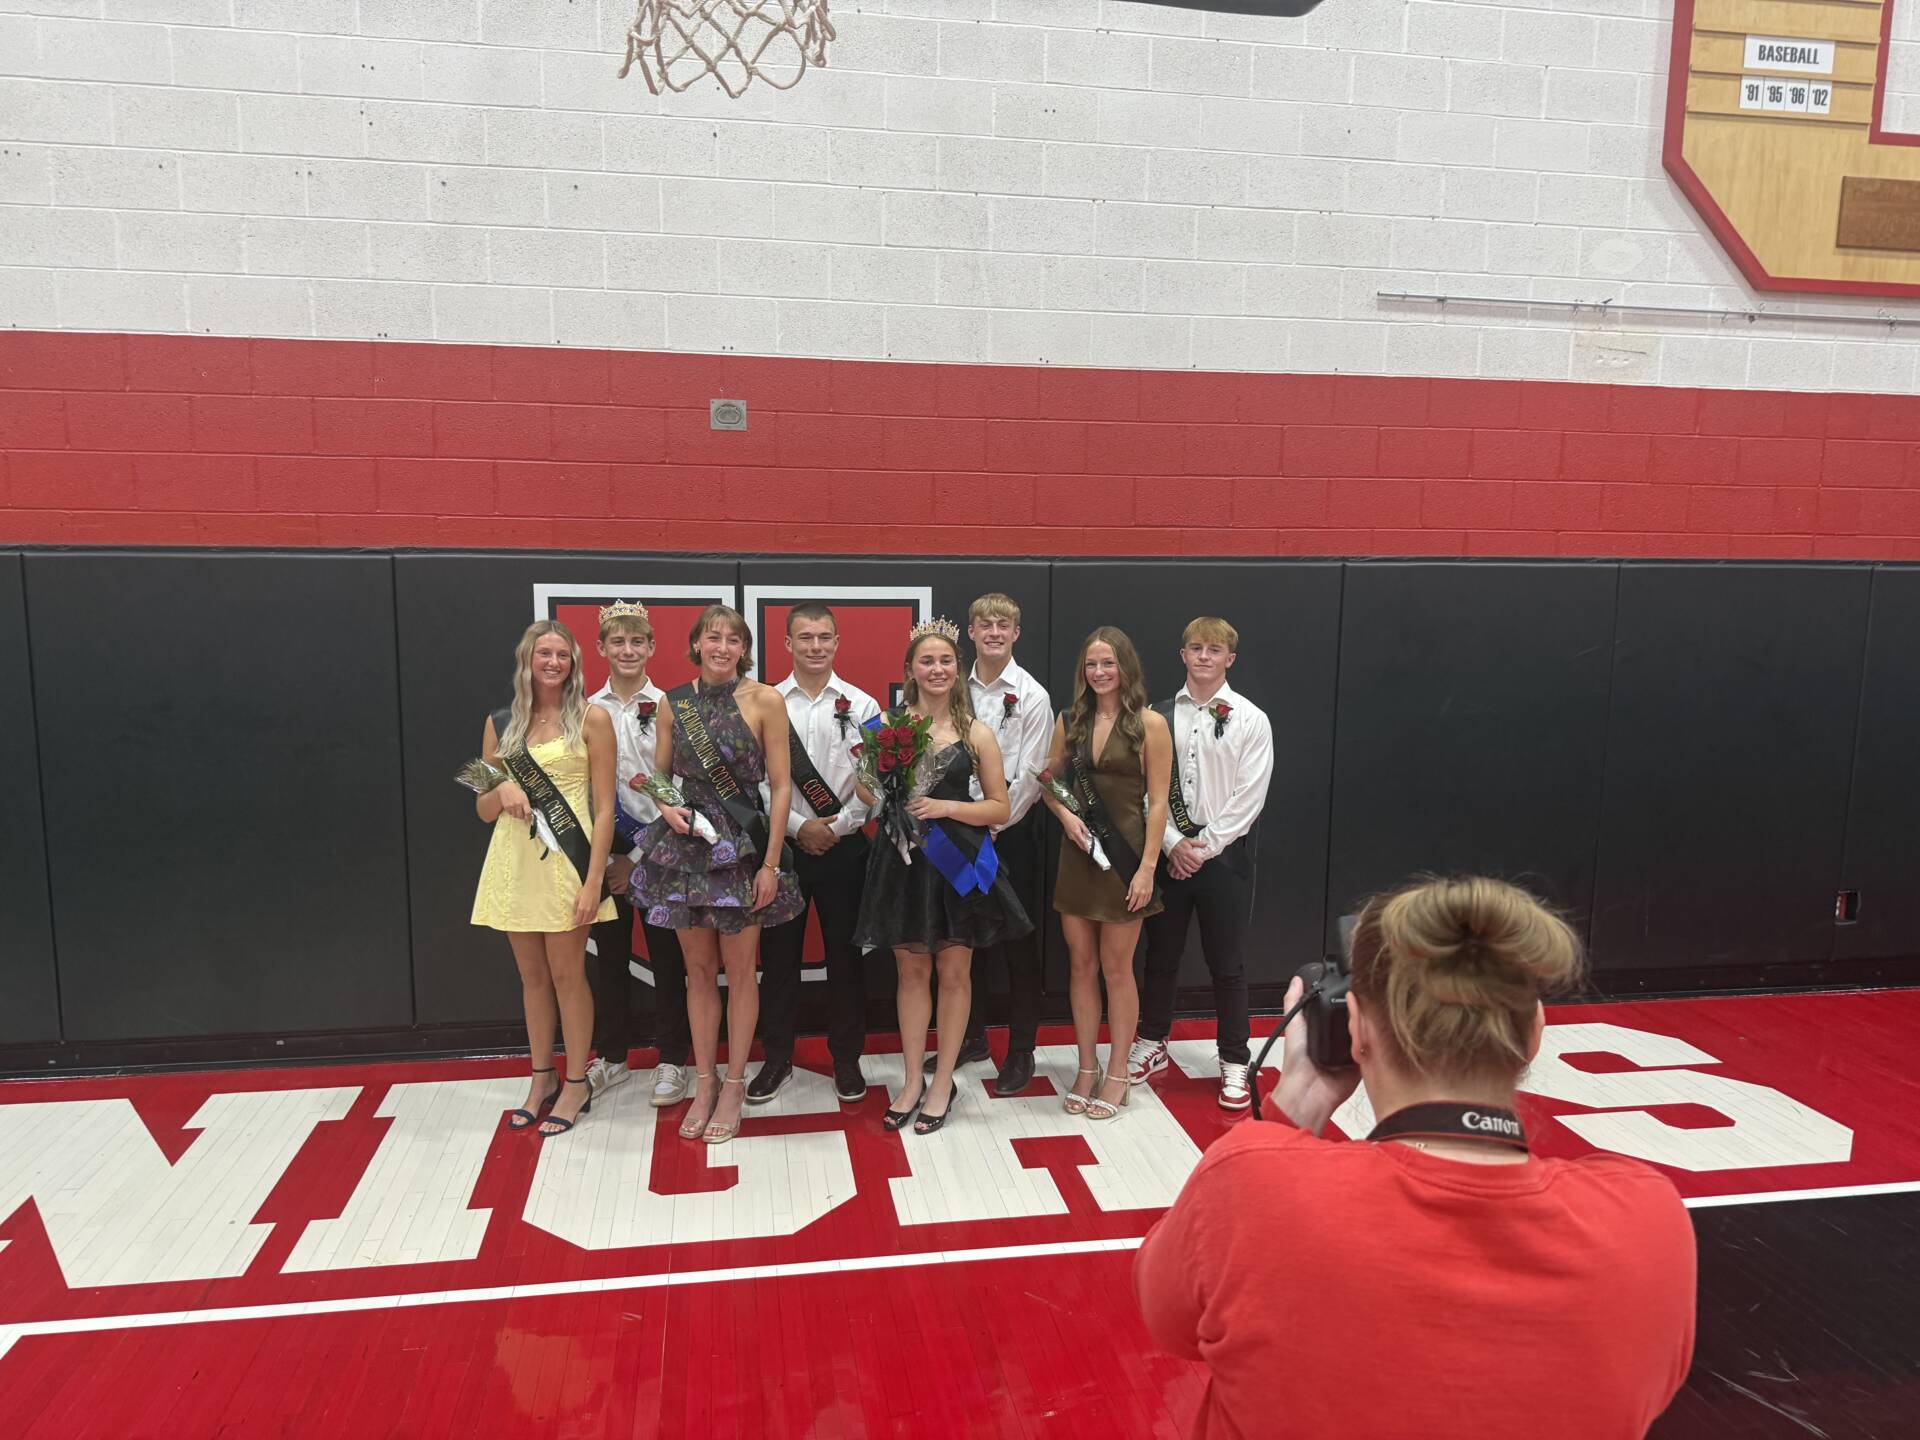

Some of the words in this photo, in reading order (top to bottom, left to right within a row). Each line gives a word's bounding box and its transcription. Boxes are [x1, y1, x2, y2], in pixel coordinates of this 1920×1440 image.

[1758, 44, 1820, 64] BASEBALL
[679, 705, 721, 769] HOMECOMING
[708, 765, 742, 801] COURT
[802, 778, 833, 810] COURT
[545, 799, 577, 836] COURT
[1171, 800, 1194, 833] COURT
[1461, 1111, 1520, 1137] Canon
[0, 1022, 1854, 1289] NIGHS
